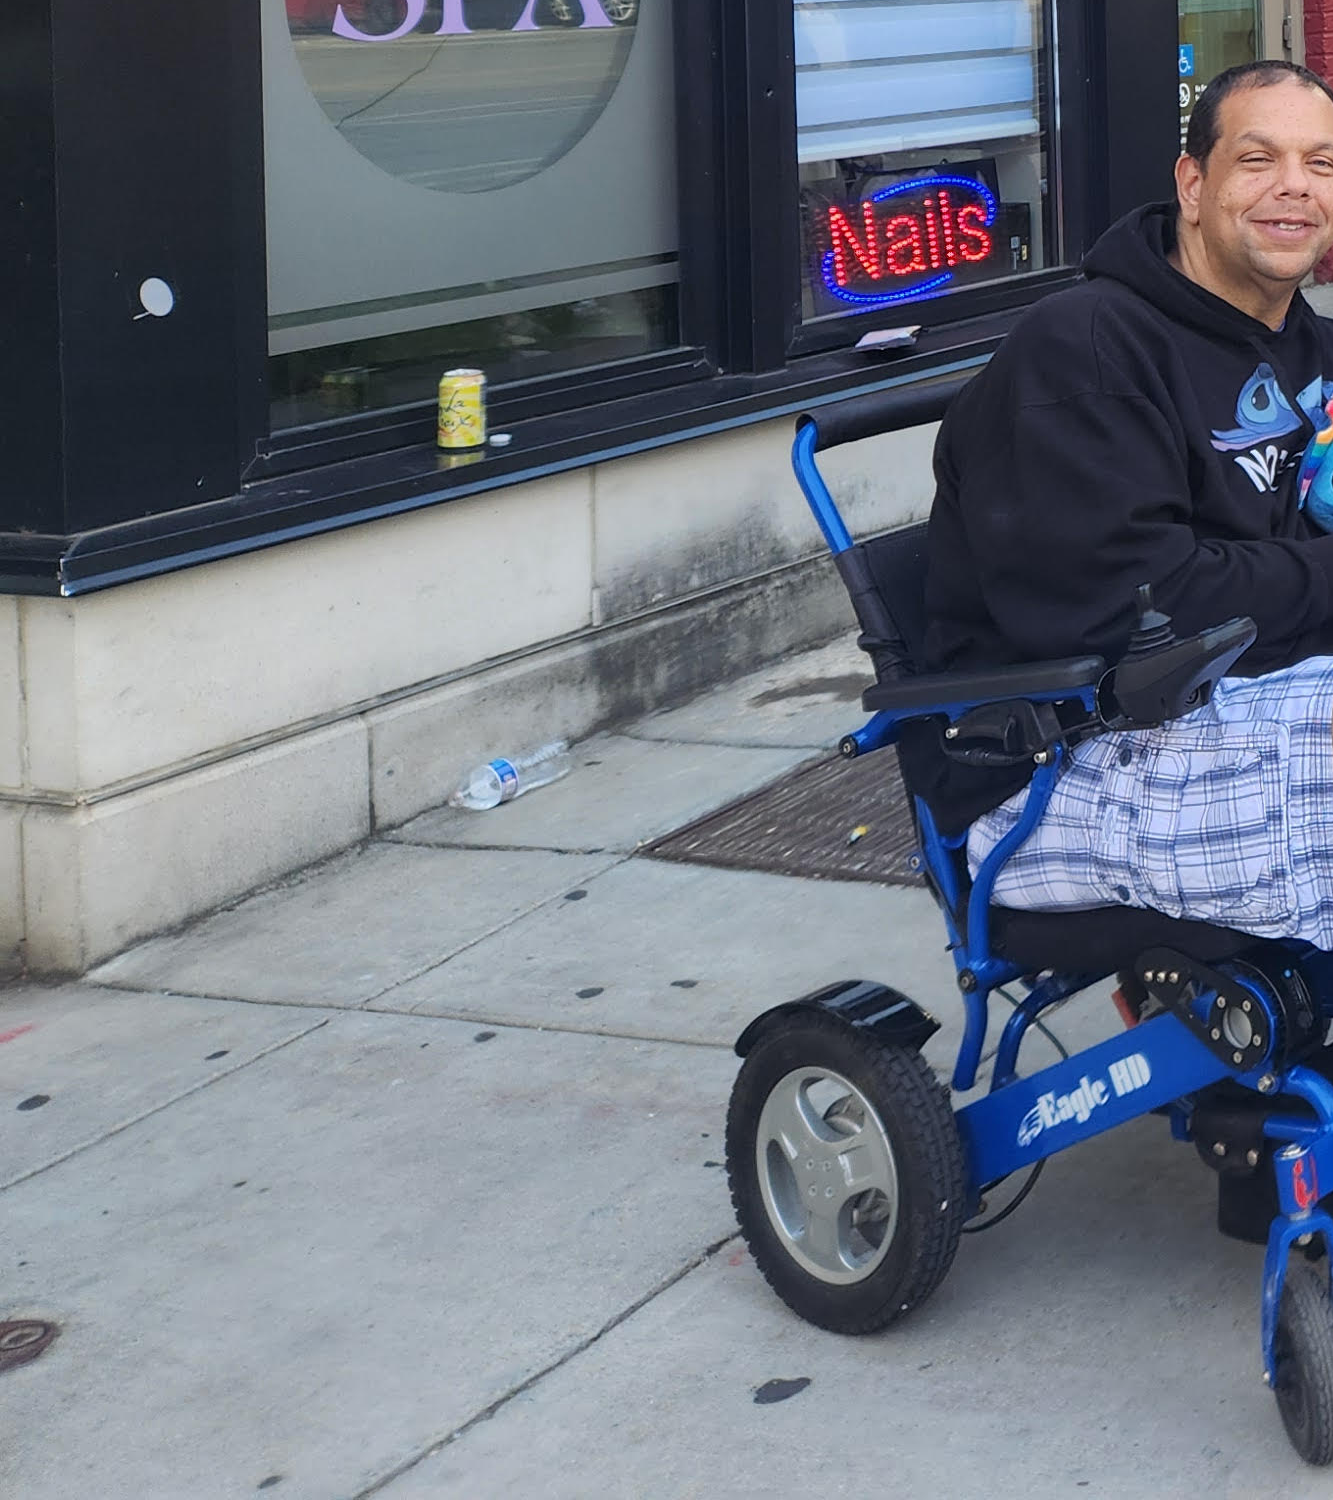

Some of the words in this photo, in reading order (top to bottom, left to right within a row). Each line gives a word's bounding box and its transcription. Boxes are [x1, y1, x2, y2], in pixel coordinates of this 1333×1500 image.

[830, 191, 992, 285] Nails
[1037, 1073, 1110, 1130] Eagle
[1108, 1053, 1152, 1098] HD
